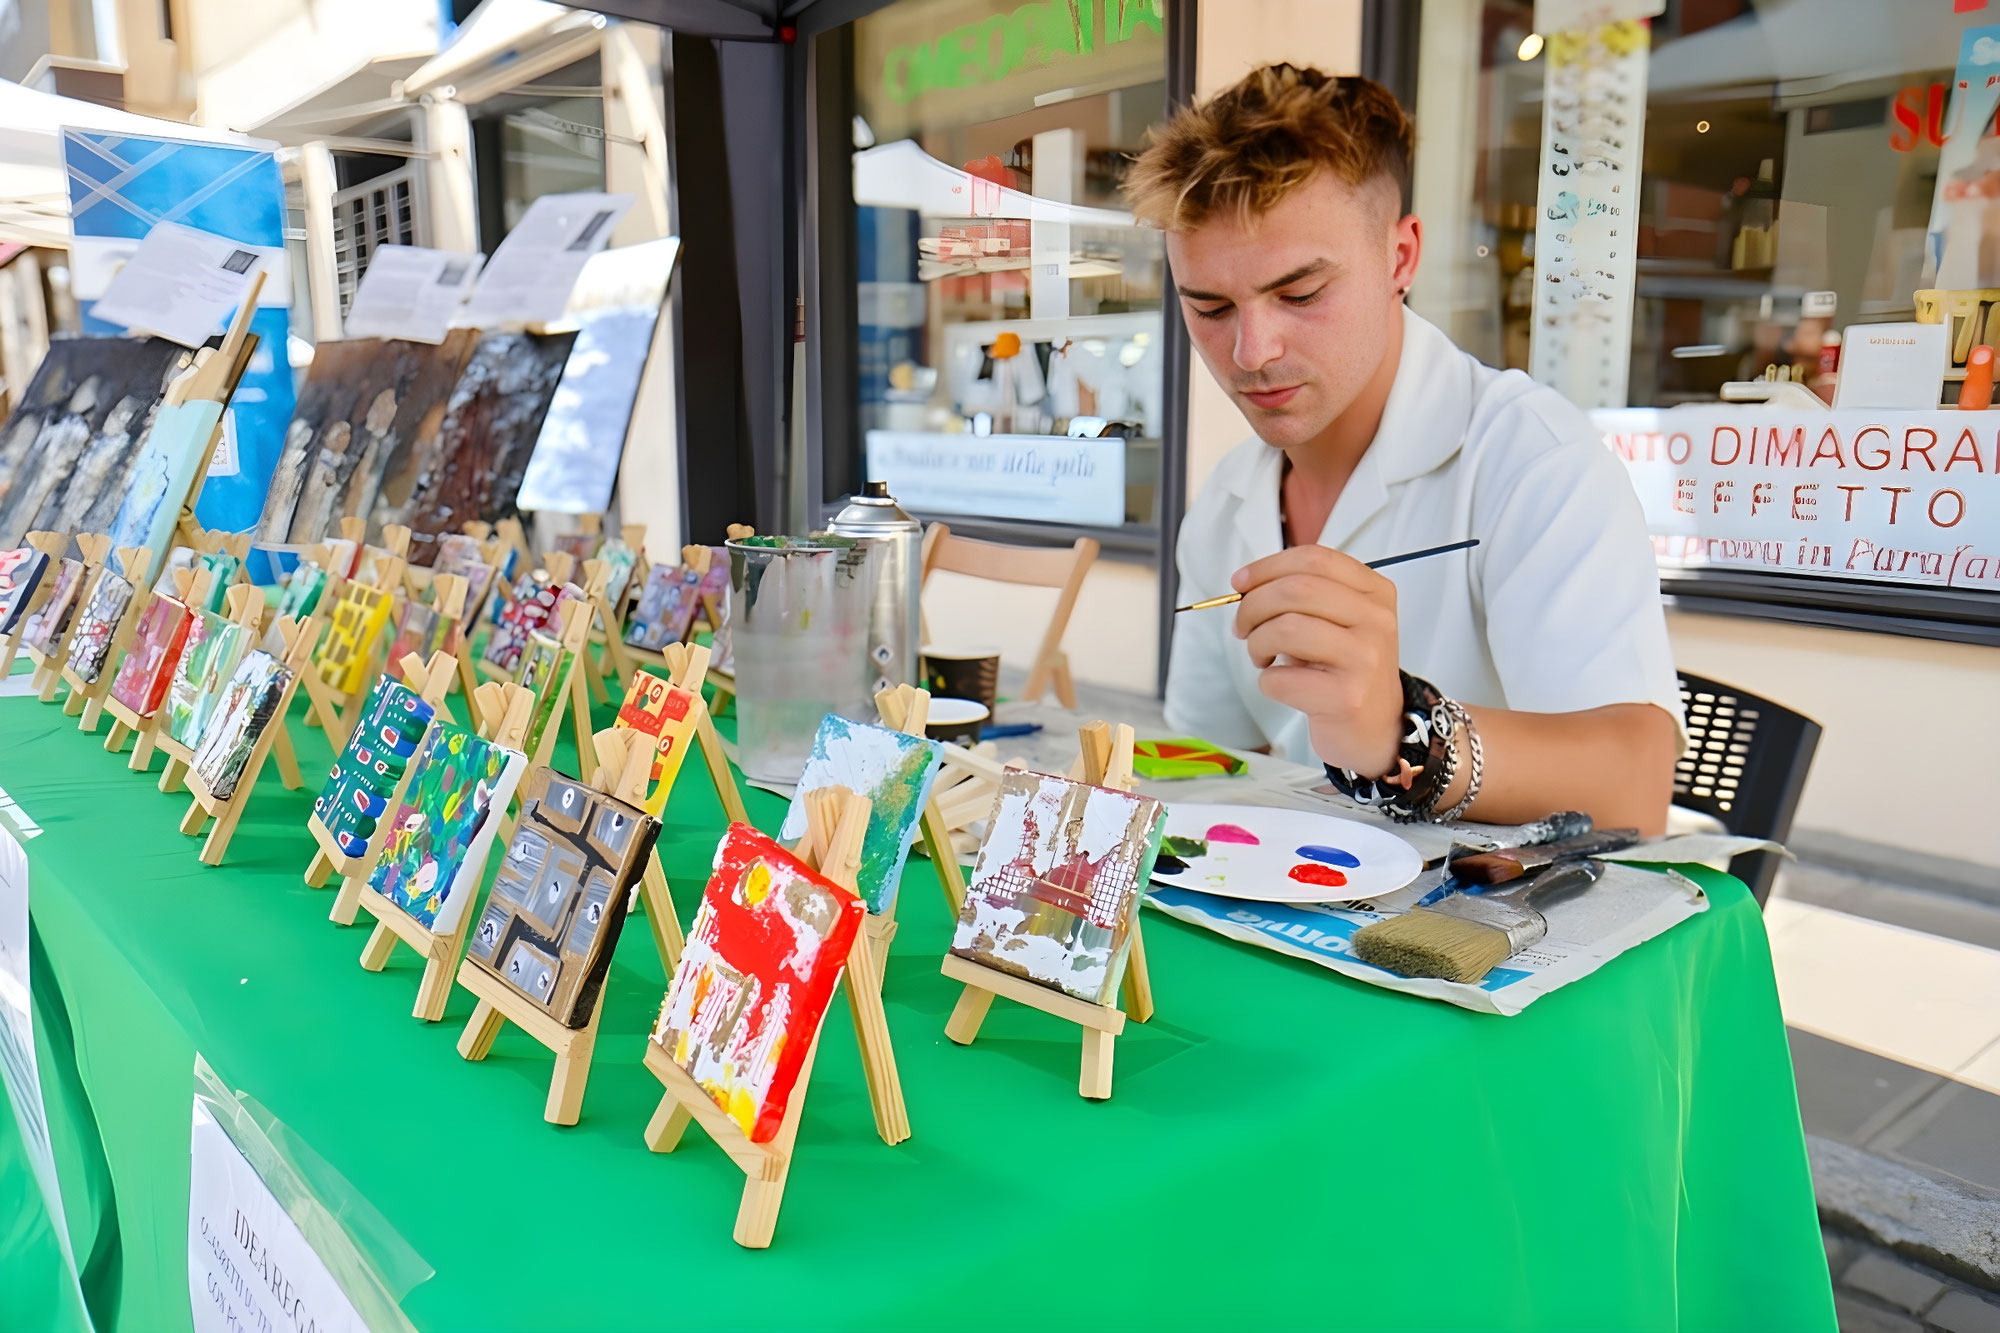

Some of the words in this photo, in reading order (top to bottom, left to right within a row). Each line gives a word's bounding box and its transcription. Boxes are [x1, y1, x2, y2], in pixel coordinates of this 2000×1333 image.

[1709, 423, 2000, 474] DIMAGRA
[1673, 479, 1967, 528] EFFETTO
[234, 1208, 268, 1285] IDEA
